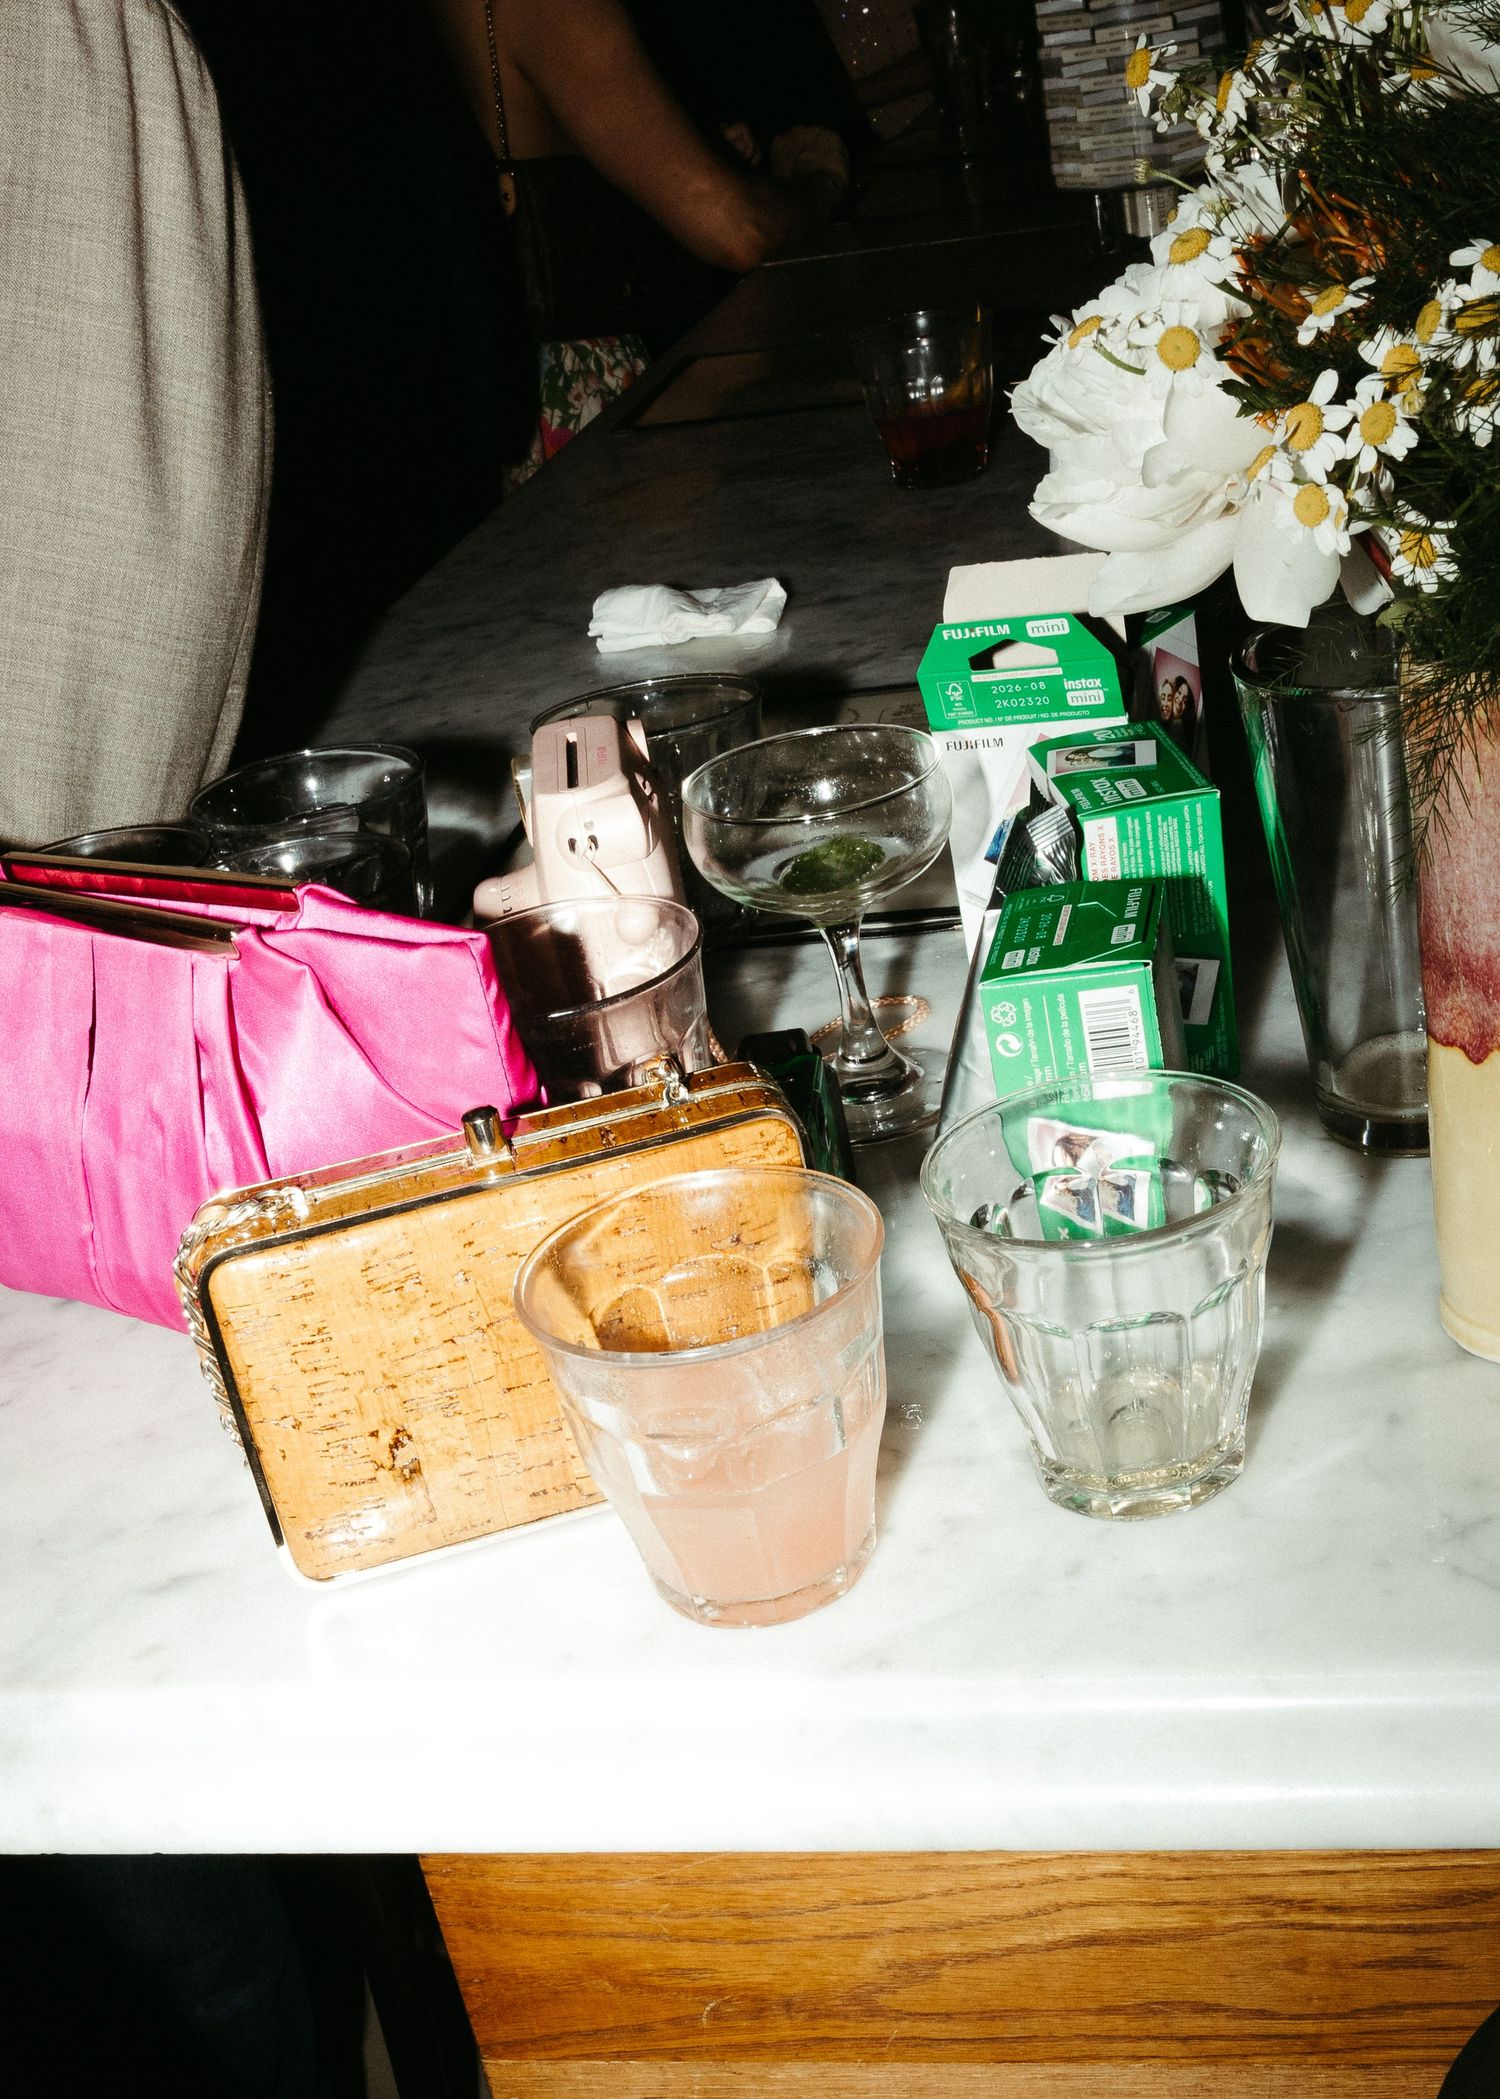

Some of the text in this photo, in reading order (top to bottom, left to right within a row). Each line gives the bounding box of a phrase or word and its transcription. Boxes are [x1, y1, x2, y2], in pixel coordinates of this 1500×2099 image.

[942, 624, 1010, 640] FUJIFILM
[1031, 621, 1065, 634] mini
[991, 682, 1046, 695] 2026-08
[1063, 678, 1102, 690] instax
[996, 697, 1050, 709] 2K02320
[1070, 693, 1101, 704] mini
[1059, 710, 1090, 718] PRODUCTO
[946, 737, 1004, 751] FUJIFILM
[1090, 777, 1122, 805] instax
[1118, 780, 1143, 798] mini
[1097, 833, 1108, 866] RAYONS
[1088, 841, 1099, 881] OM X-RAY
[1108, 845, 1118, 872] RAYOS
[1101, 868, 1109, 881] ES
[1124, 888, 1142, 918] FUJIFILM
[1117, 926, 1132, 942] mini
[1027, 945, 1045, 967] instax
[1022, 998, 1032, 1022] imagen
[1056, 993, 1069, 1021] película
[1025, 1021, 1033, 1029] la
[1128, 1010, 1142, 1045] 94468
[1027, 1029, 1035, 1038] de
[1061, 1028, 1070, 1039] de
[1063, 1039, 1075, 1066] Tamaño
[1133, 1052, 1145, 1070] 101
